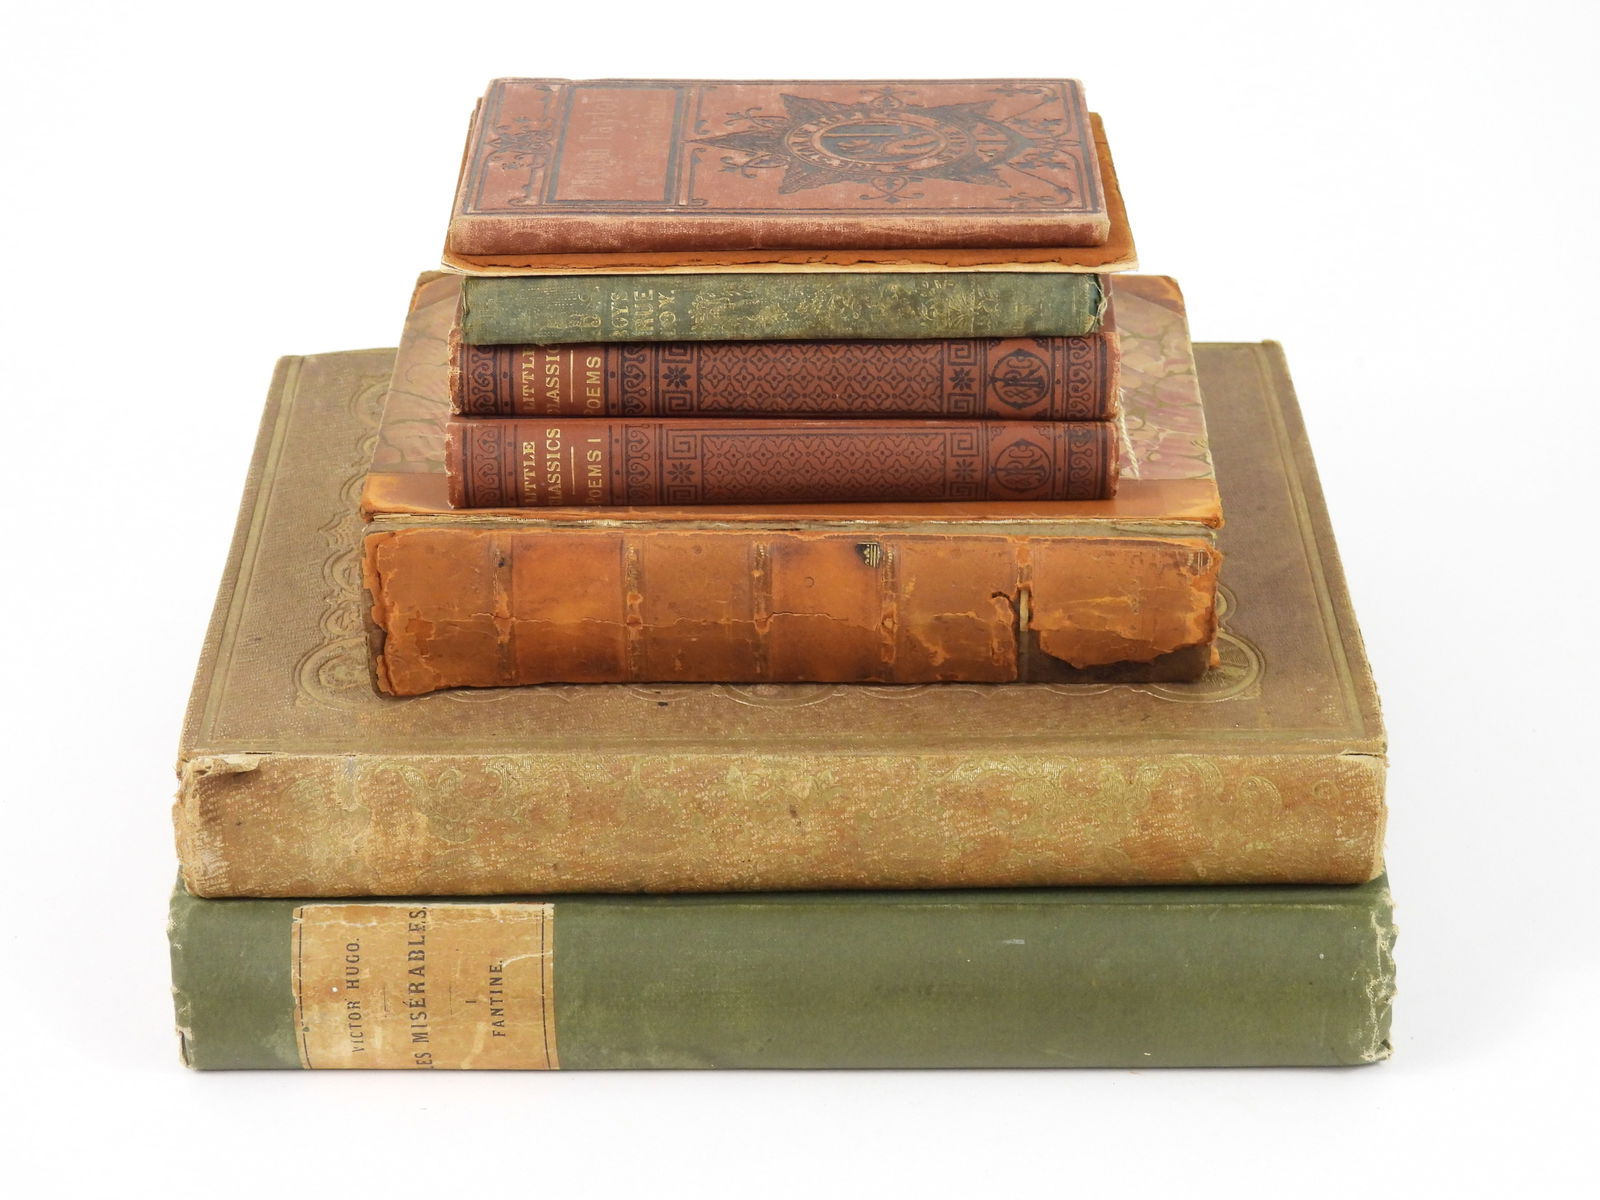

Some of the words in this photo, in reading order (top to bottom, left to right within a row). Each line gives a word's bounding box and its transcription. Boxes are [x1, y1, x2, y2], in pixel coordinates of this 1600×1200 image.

[545, 345, 561, 415] LASSIC
[346, 938, 361, 990] HUGO.
[347, 998, 365, 1053] VICTOR
[489, 960, 506, 1038] FANTINE.
